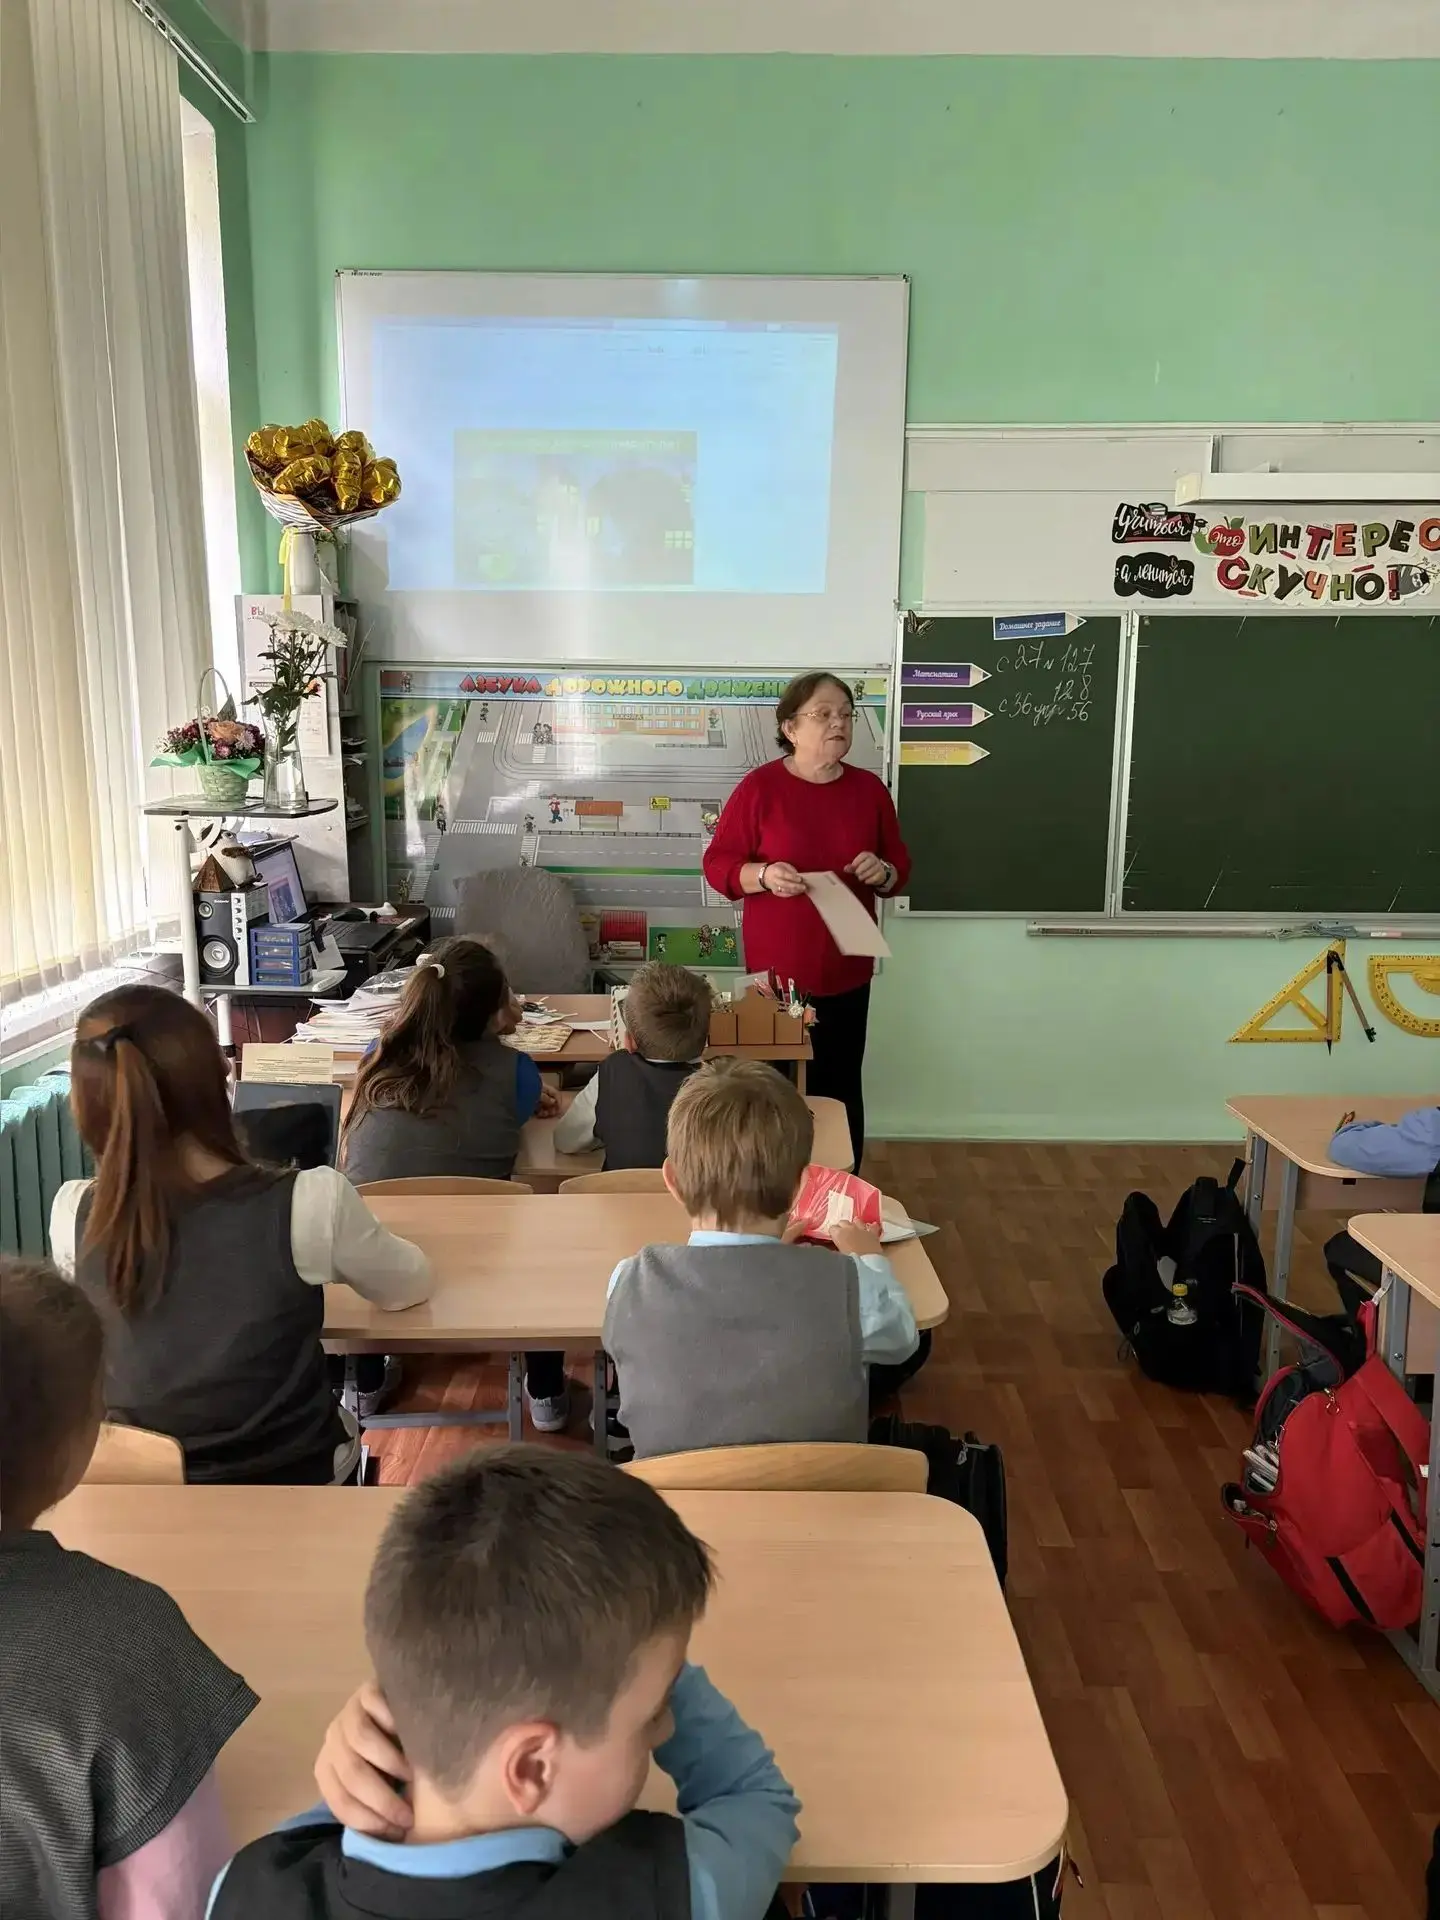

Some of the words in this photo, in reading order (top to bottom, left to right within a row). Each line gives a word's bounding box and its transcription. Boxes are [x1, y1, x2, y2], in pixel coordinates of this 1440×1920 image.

[999, 622, 1034, 631] Домашнее
[1034, 620, 1061, 631] задание
[1014, 641, 1044, 670] 27
[912, 669, 959, 678] Математика
[459, 674, 542, 694] АЗБУКА
[544, 676, 684, 697] ДОРОЖНОГО
[916, 709, 942, 720] Русский
[942, 712, 959, 720] язык
[1008, 691, 1032, 719] 36
[1066, 701, 1093, 721] 56
